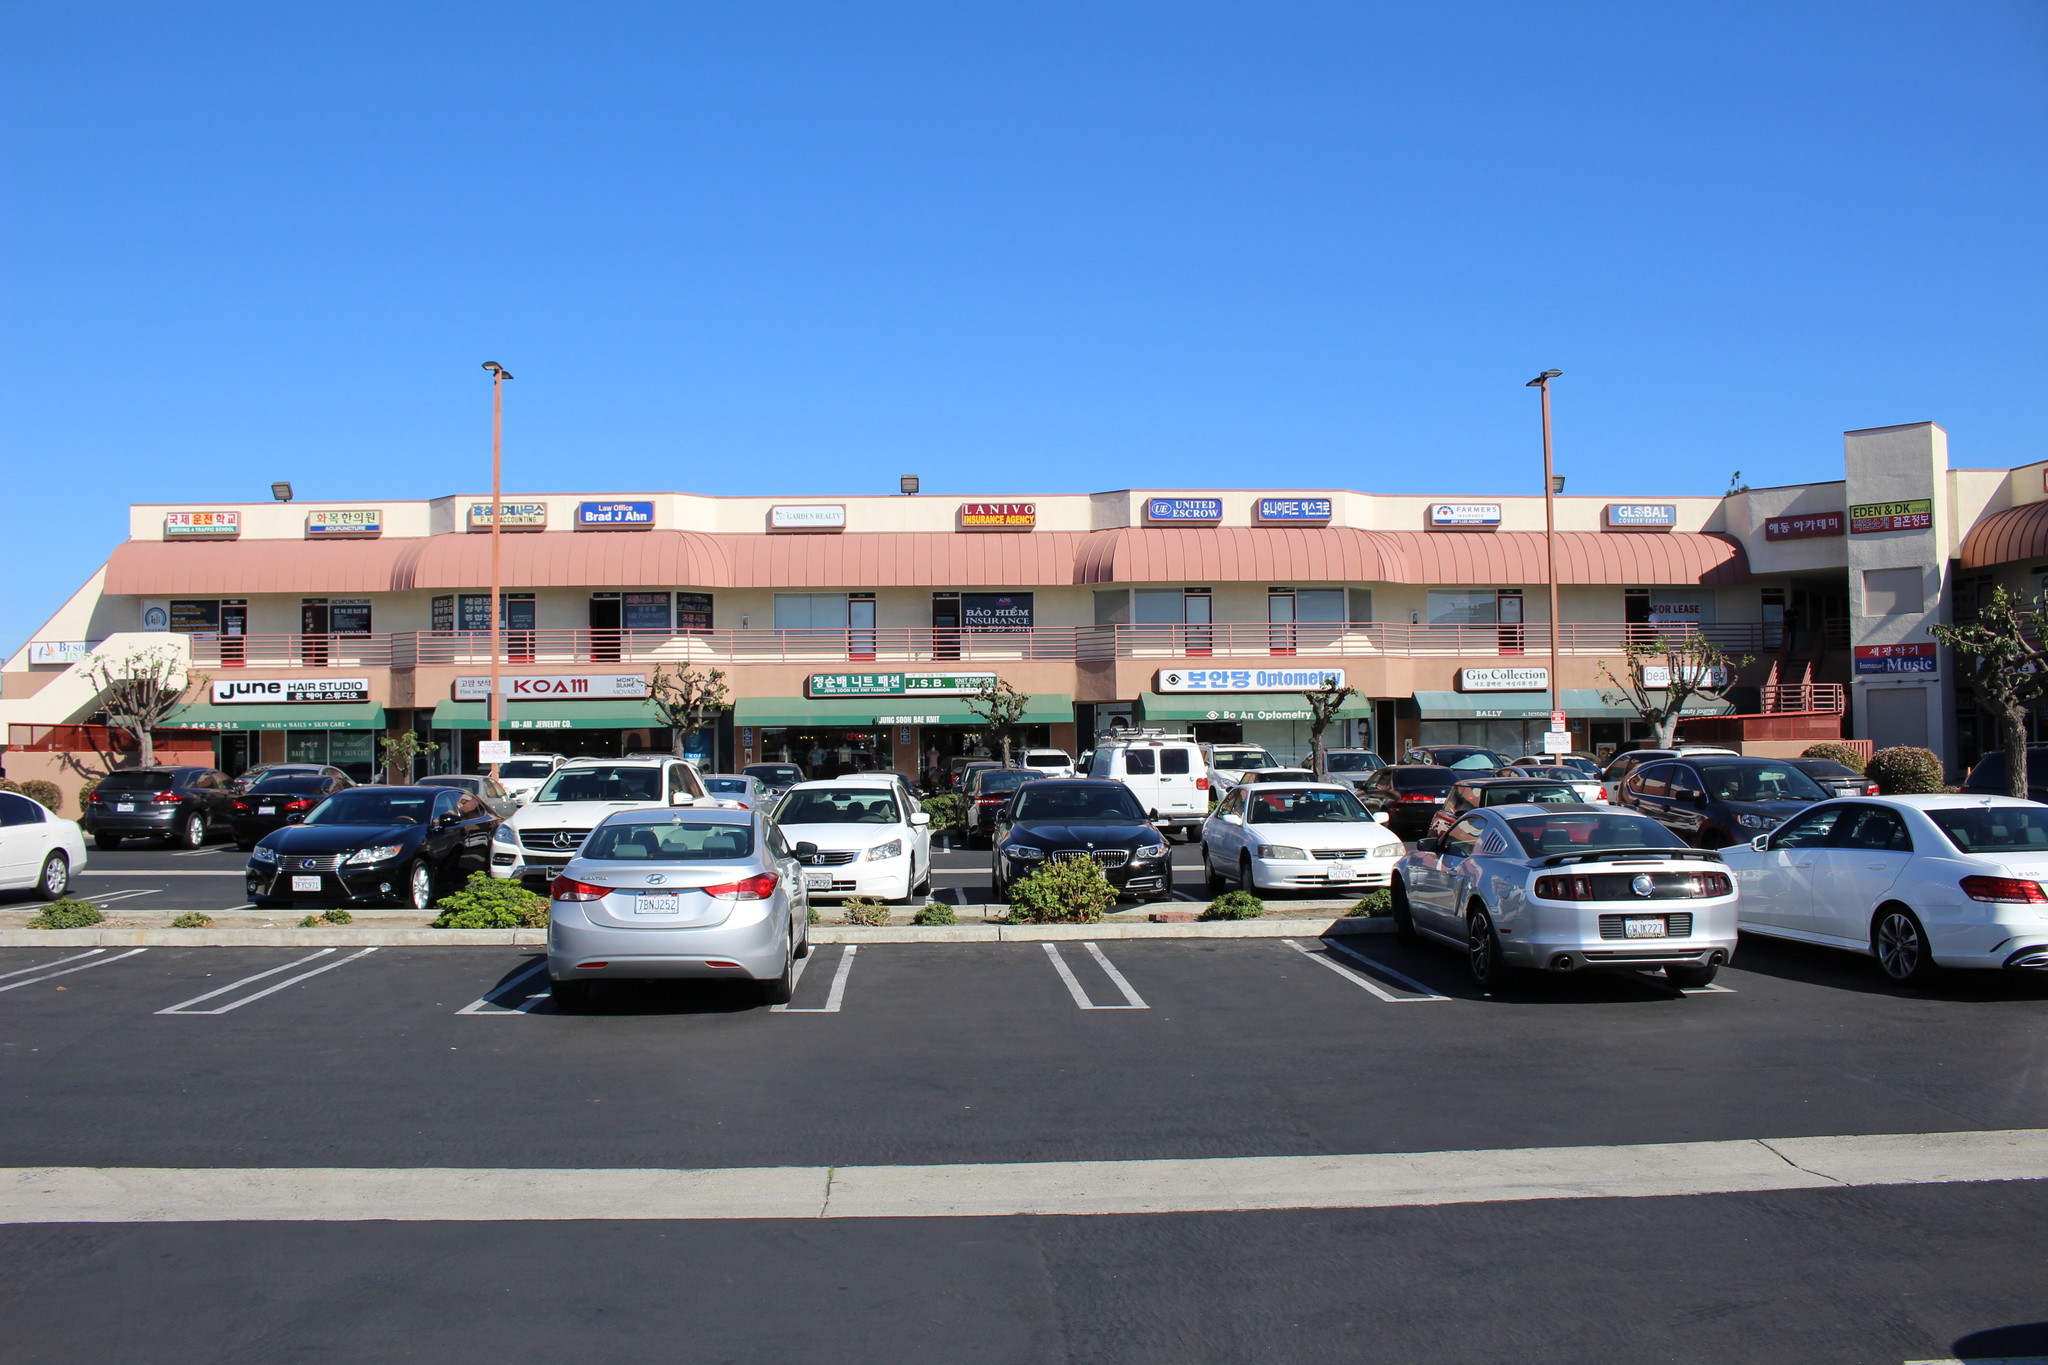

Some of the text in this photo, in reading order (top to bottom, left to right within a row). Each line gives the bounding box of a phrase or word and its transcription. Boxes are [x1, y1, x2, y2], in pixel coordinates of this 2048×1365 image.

[473, 504, 544, 516] 효성계사무소
[613, 504, 634, 512] Office
[964, 504, 1035, 515] LANIVO
[1155, 505, 1169, 513] UE
[1263, 501, 1331, 516] 유나이티드 에스크로
[1618, 505, 1669, 518] GLOBAL
[1853, 506, 1882, 518] EDEN
[1884, 505, 1893, 516] &
[1894, 503, 1910, 515] DK
[315, 512, 376, 524] 화목한의원
[585, 511, 648, 522] Brad J Ahn
[786, 511, 841, 520] GARDEN REALTY
[1173, 510, 1218, 518] ESCROW
[963, 515, 1035, 525] INSURANCE AGENCY
[1793, 517, 1838, 532] 아카데미
[1893, 514, 1930, 528] 결혼정보
[966, 607, 992, 617] BẢO
[1653, 604, 1700, 614] FOR LEASE
[965, 617, 1030, 625] INSURANCE
[1868, 645, 1919, 657] 세광악기
[1886, 657, 1933, 672] Music
[1187, 671, 1252, 689] 보안당
[1466, 669, 1547, 681] Gio Collection
[287, 681, 363, 691] HAIR STUDIO
[813, 675, 900, 688] 정순배 니트 패션
[908, 678, 946, 688] J.S.B.
[295, 692, 359, 700] 준 헤어 스튜디오
[879, 716, 895, 724] JUNG
[1223, 710, 1312, 720] Bo An Optometry
[561, 720, 573, 728] CO.
[637, 899, 677, 911] 7BNJ252
